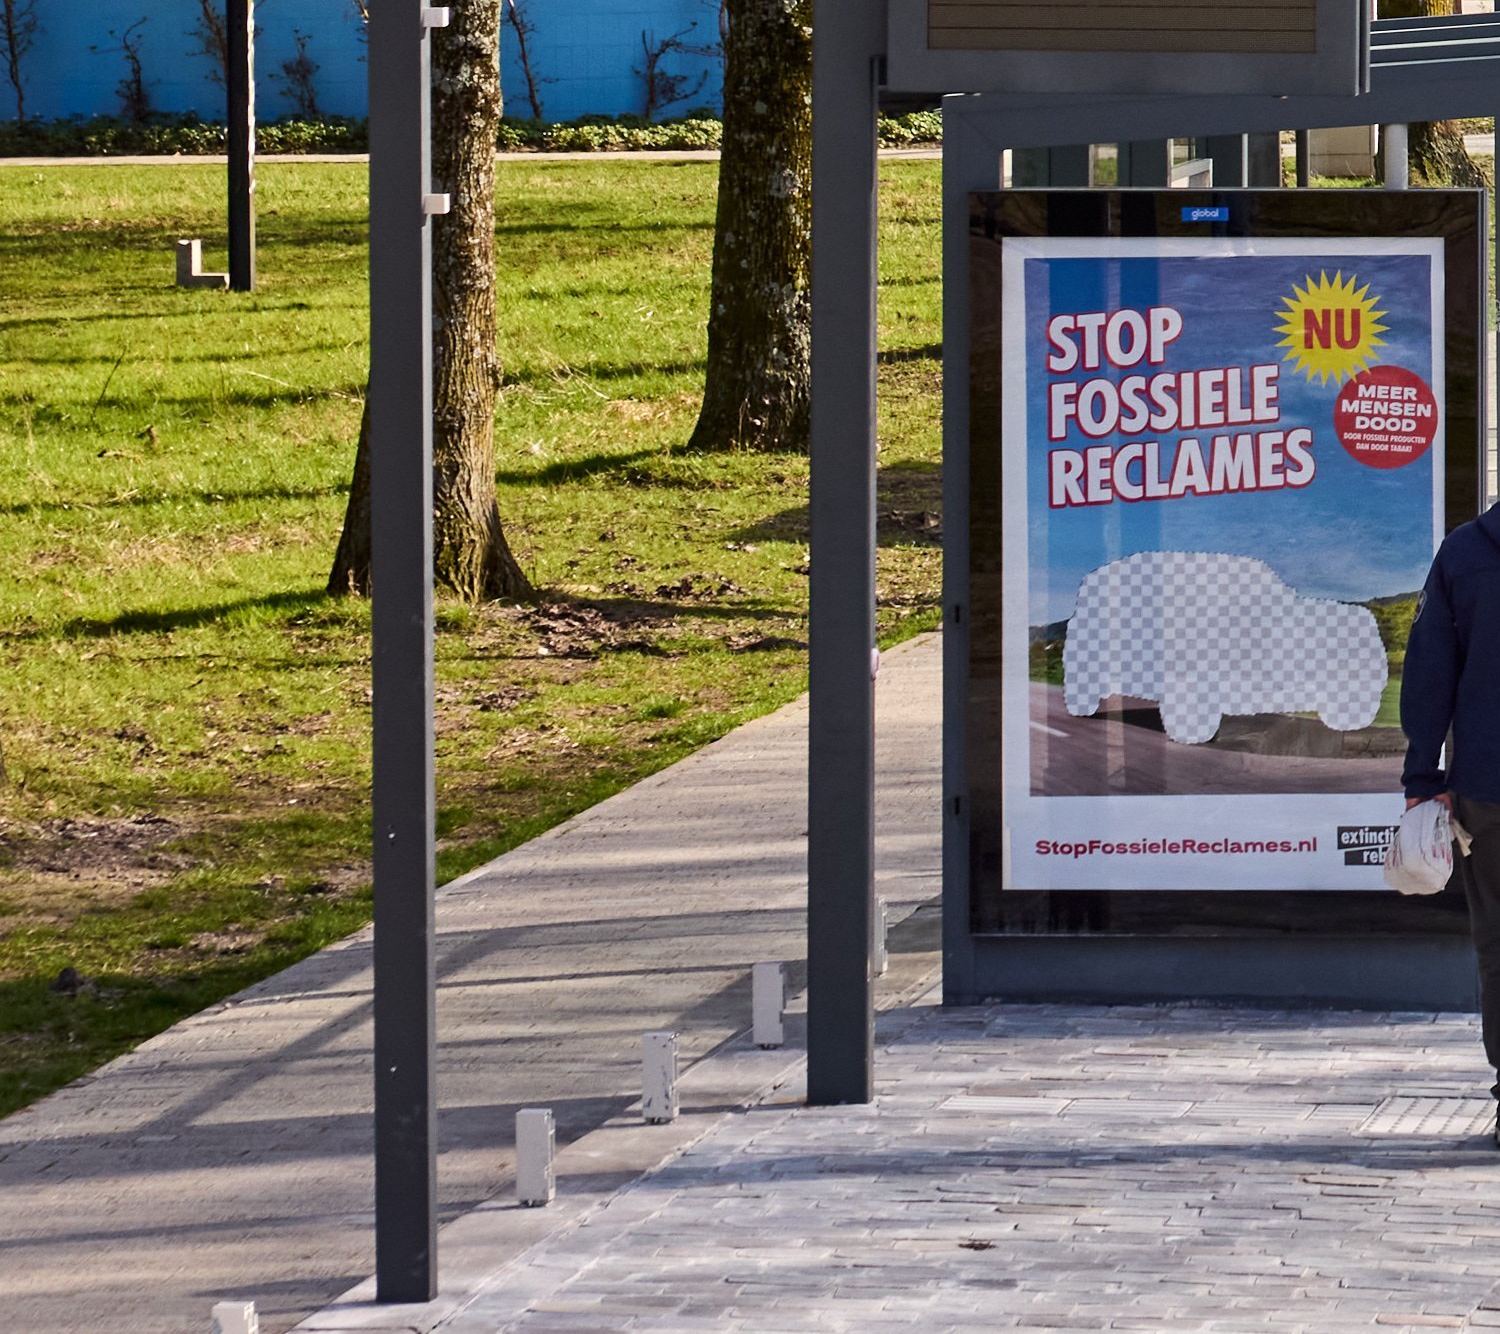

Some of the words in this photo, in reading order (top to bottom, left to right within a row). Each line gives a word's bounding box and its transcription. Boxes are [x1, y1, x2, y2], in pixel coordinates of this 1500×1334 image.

[1191, 207, 1219, 221] global
[1047, 306, 1183, 373] STOP
[1303, 307, 1362, 351] NU
[1048, 363, 1281, 441] FOSSIELE
[1358, 384, 1418, 402] MEER
[1341, 398, 1433, 418] MENSEN
[1354, 414, 1417, 433] DOOD
[1049, 428, 1316, 508] RECLAMES
[1035, 834, 1318, 862] StopFossieleReclames.nl
[1341, 827, 1396, 845] extincti
